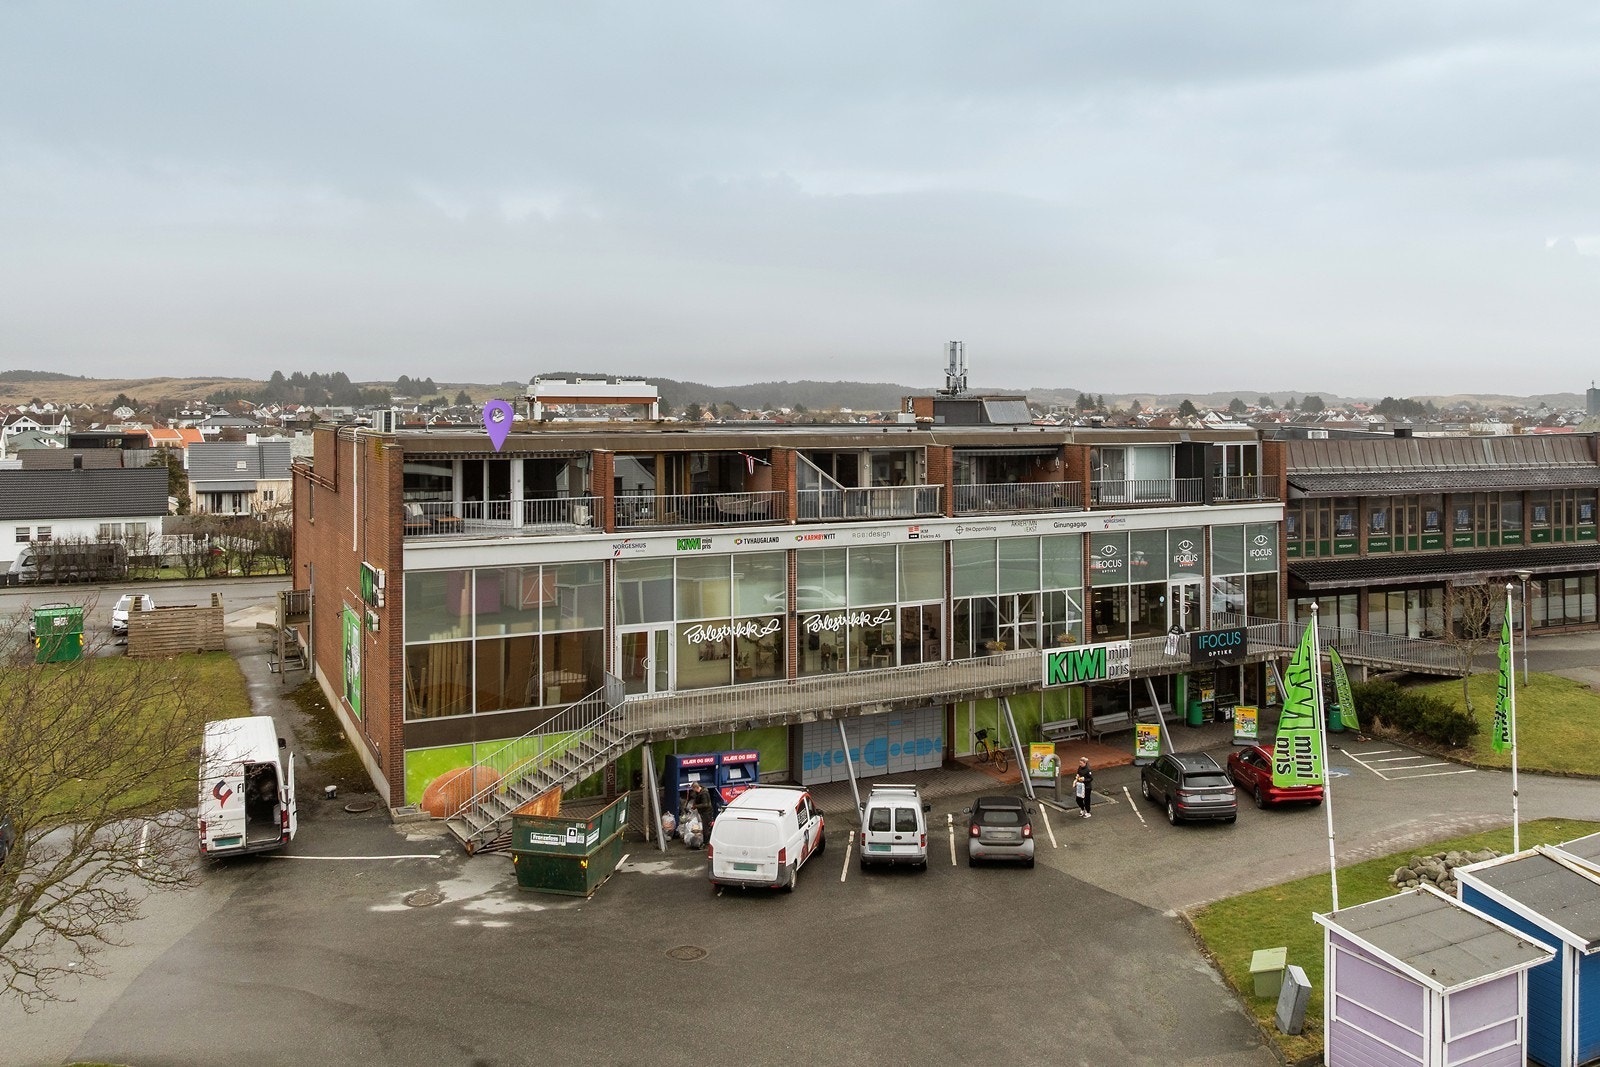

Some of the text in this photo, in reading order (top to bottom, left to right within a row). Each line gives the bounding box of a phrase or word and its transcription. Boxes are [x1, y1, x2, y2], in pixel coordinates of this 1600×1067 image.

[1053, 521, 1088, 529] Ginungagap
[612, 542, 647, 551] NORGESHUS
[676, 537, 701, 551] KIWI
[702, 543, 711, 551] pris
[1173, 553, 1198, 564] IFOCUS
[1249, 548, 1273, 558] IFOCUS
[1198, 630, 1241, 650] IFOCUS
[1108, 645, 1131, 660] mini
[1208, 648, 1233, 657] OPTIKK
[1047, 646, 1107, 686] KIWI
[1108, 661, 1129, 679] pris
[1294, 735, 1319, 779] mini
